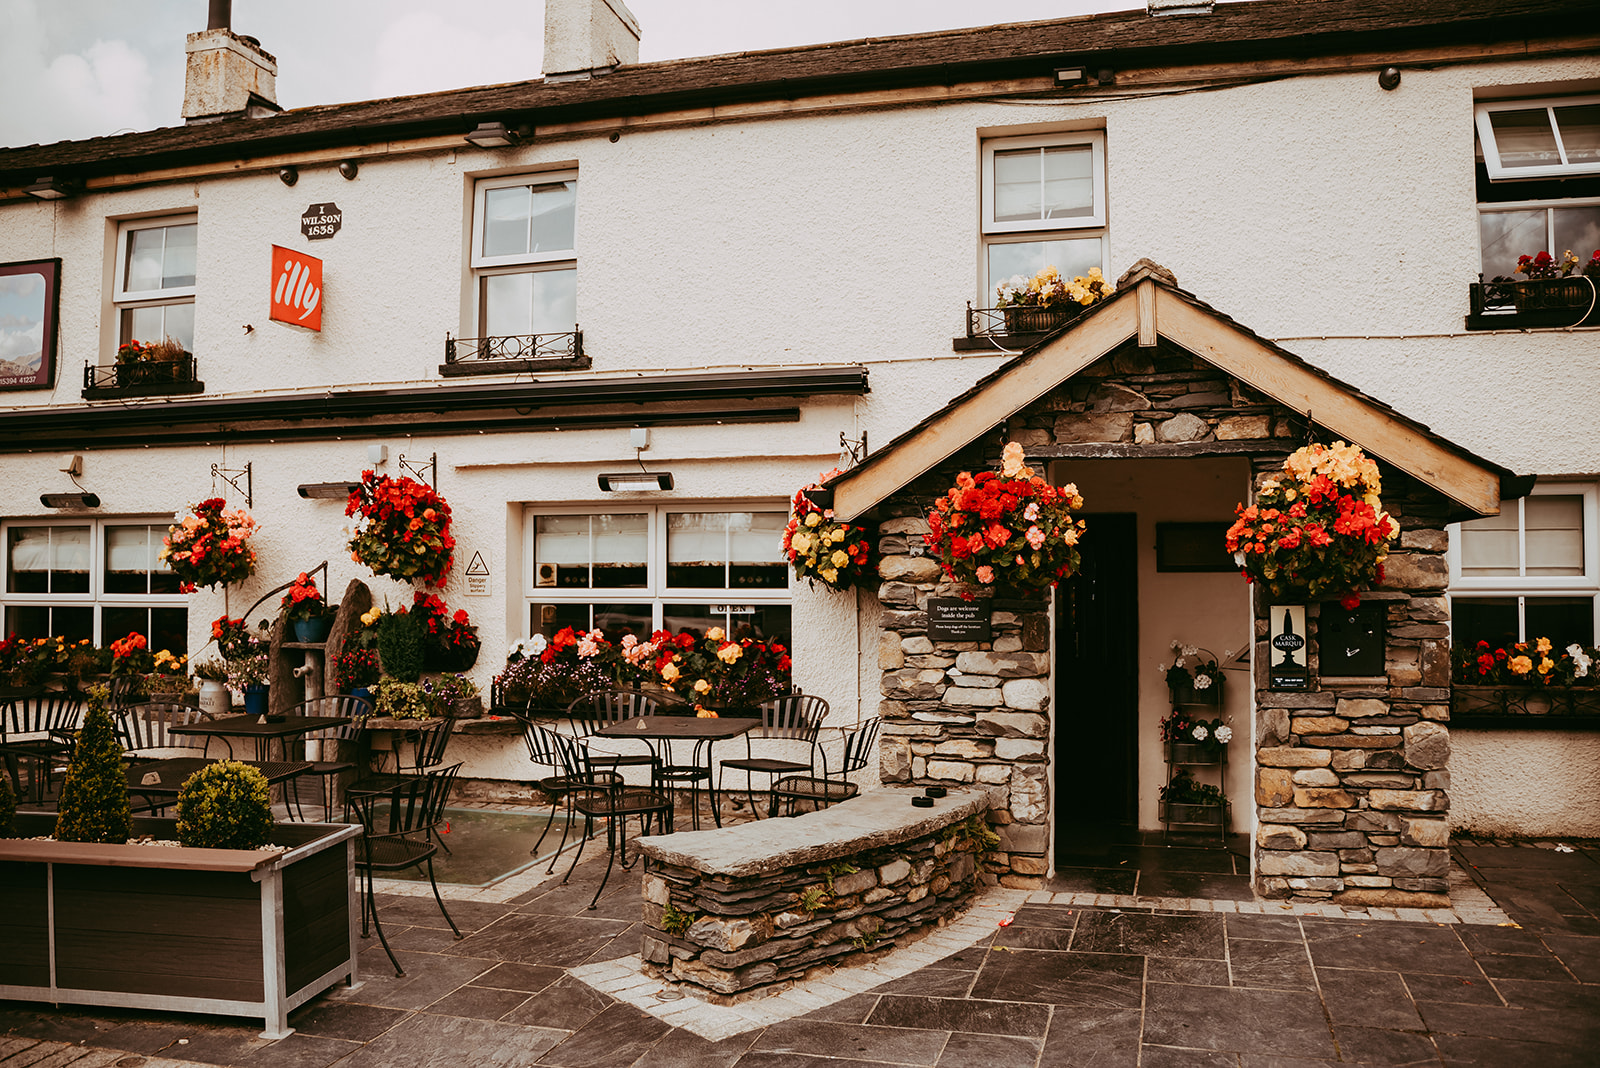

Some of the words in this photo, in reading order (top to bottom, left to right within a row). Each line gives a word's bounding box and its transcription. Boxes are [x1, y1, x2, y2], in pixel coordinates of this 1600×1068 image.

[319, 206, 325, 214] I
[302, 214, 341, 225] WILSON
[275, 260, 320, 320] illy
